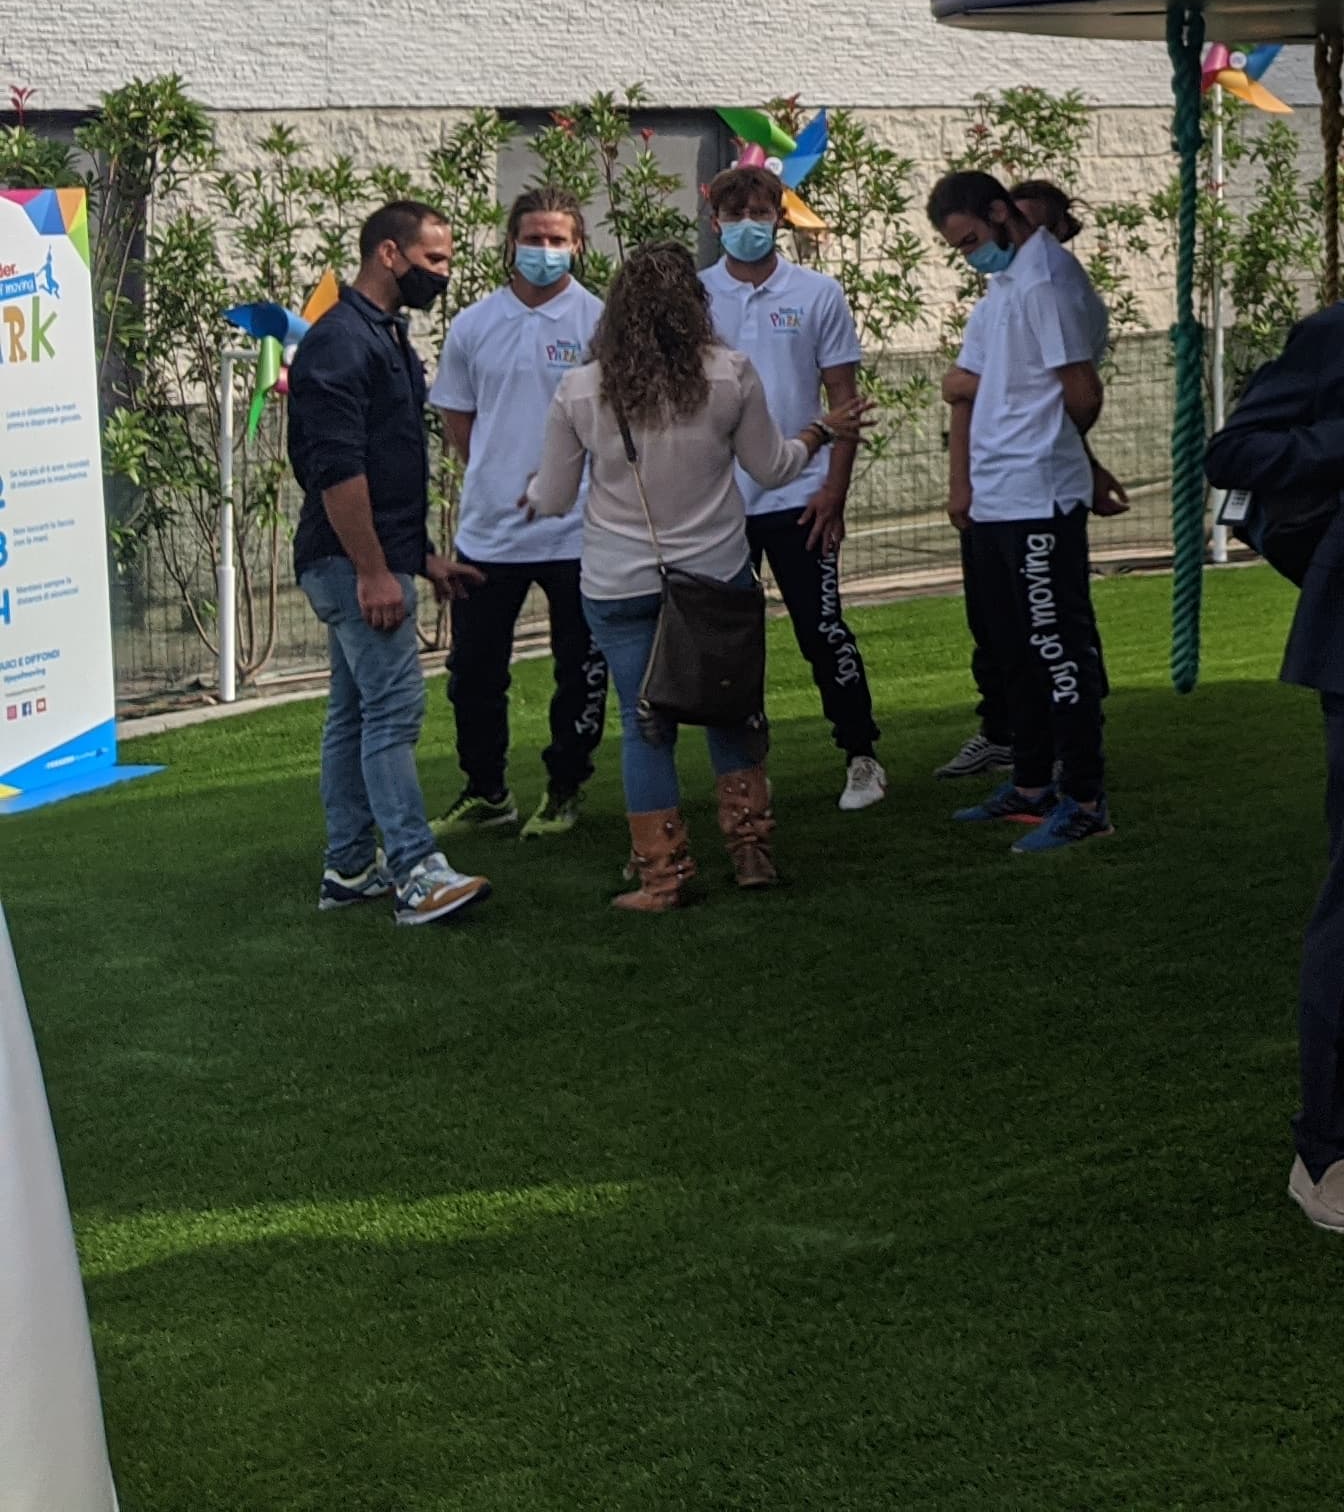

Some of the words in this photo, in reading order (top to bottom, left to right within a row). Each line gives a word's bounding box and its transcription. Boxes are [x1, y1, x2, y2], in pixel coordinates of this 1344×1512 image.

[0, 296, 57, 364] RK
[1019, 533, 1056, 627] moving
[834, 642, 860, 687] Joy
[1030, 634, 1063, 659] of
[1049, 660, 1079, 704] Joy
